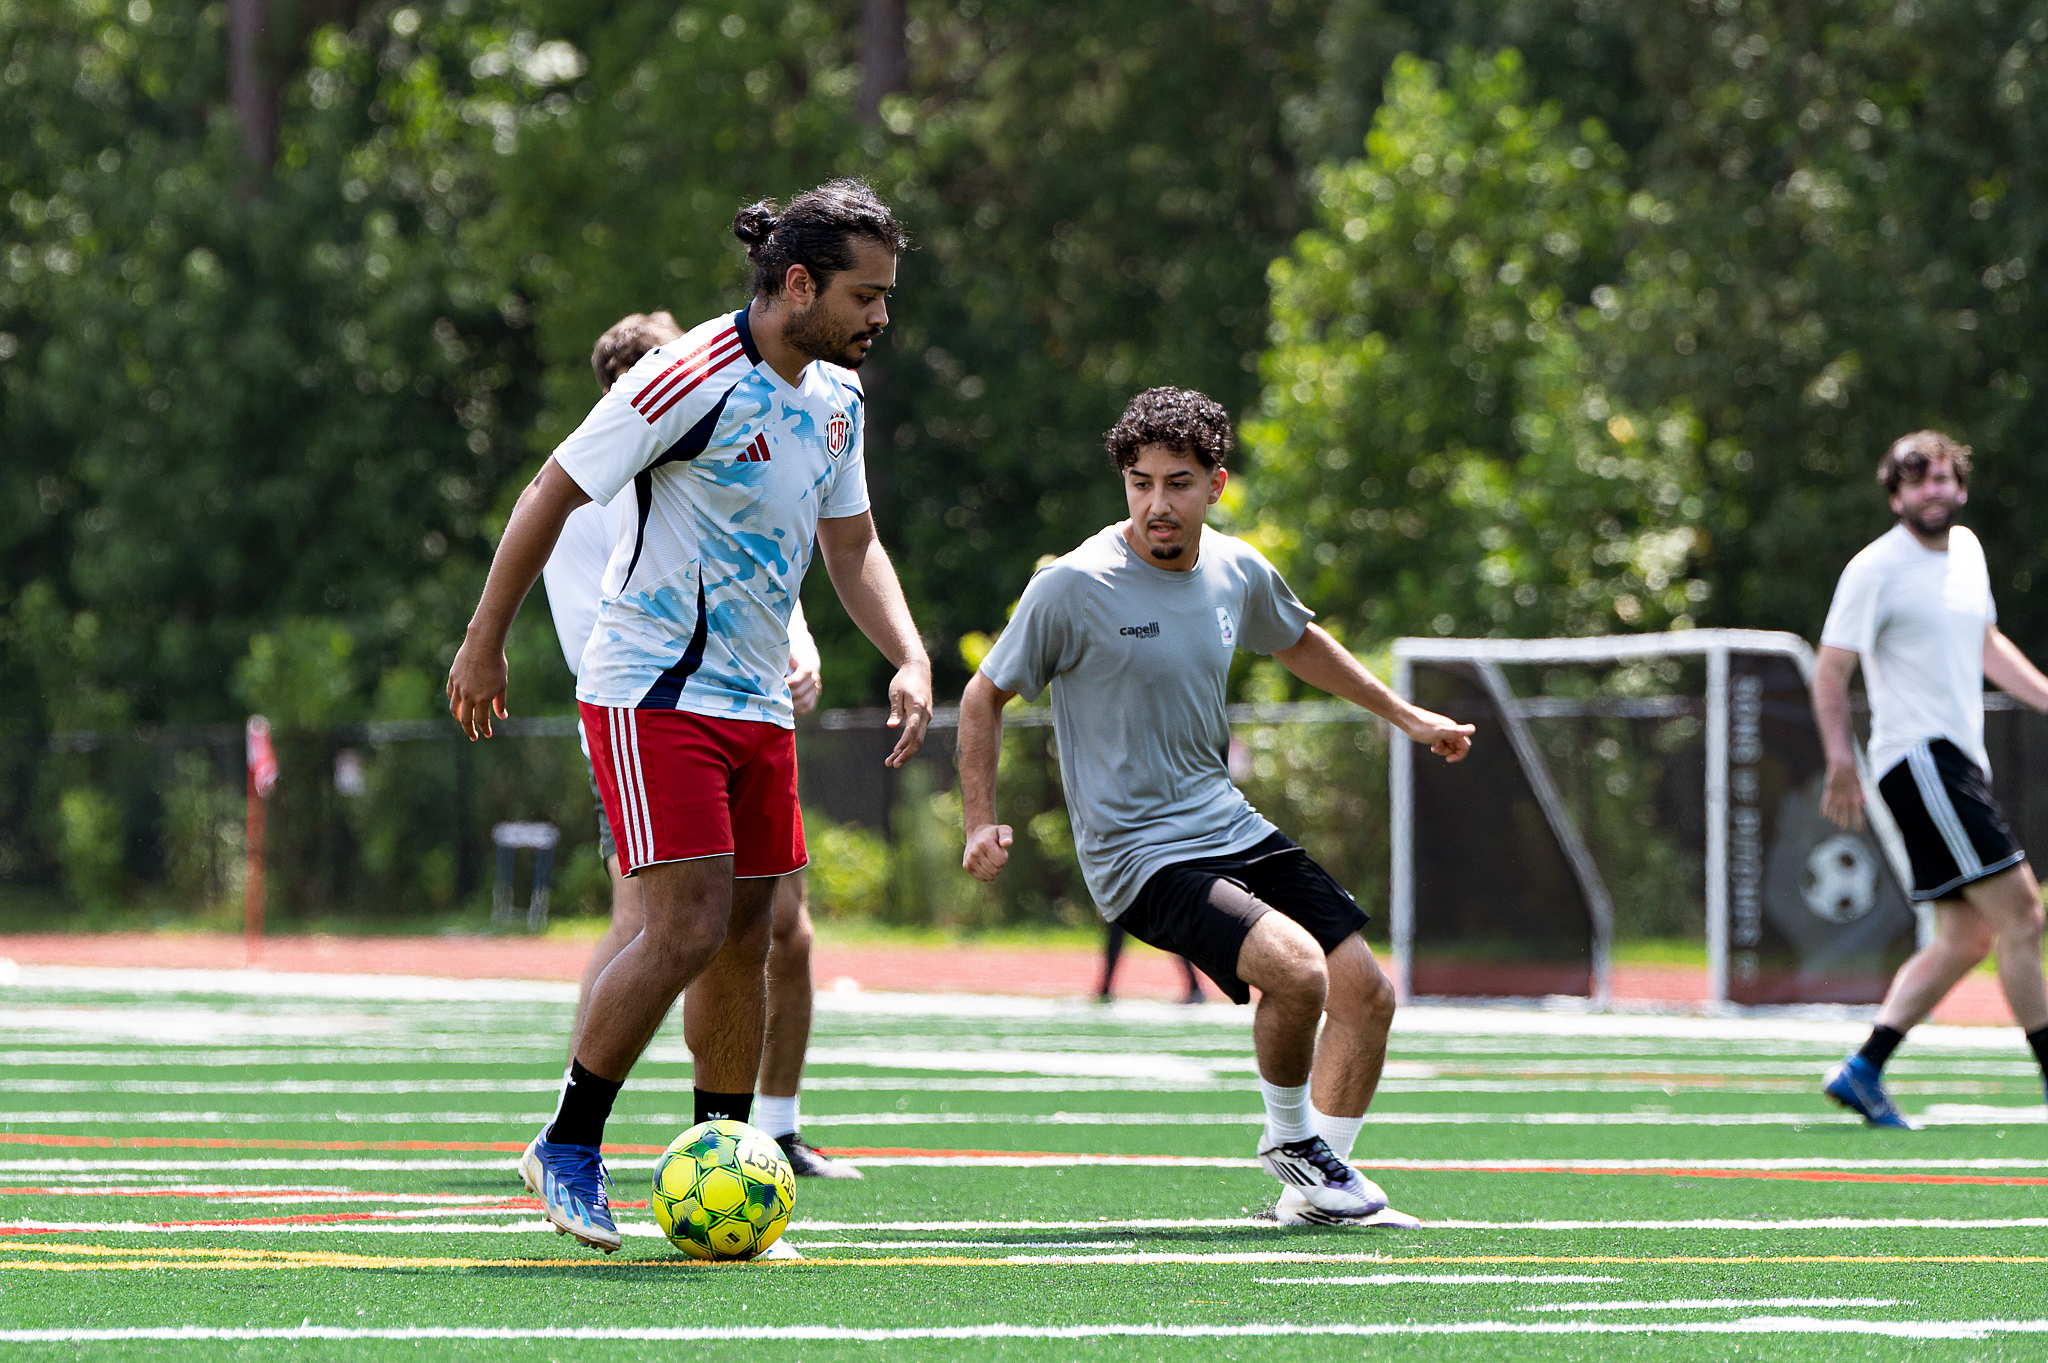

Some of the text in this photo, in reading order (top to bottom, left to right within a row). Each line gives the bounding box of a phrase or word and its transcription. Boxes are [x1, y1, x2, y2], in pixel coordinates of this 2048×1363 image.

[830, 420, 845, 451] CR
[1119, 621, 1160, 638] capelli
[744, 1149, 795, 1202] SELECT
